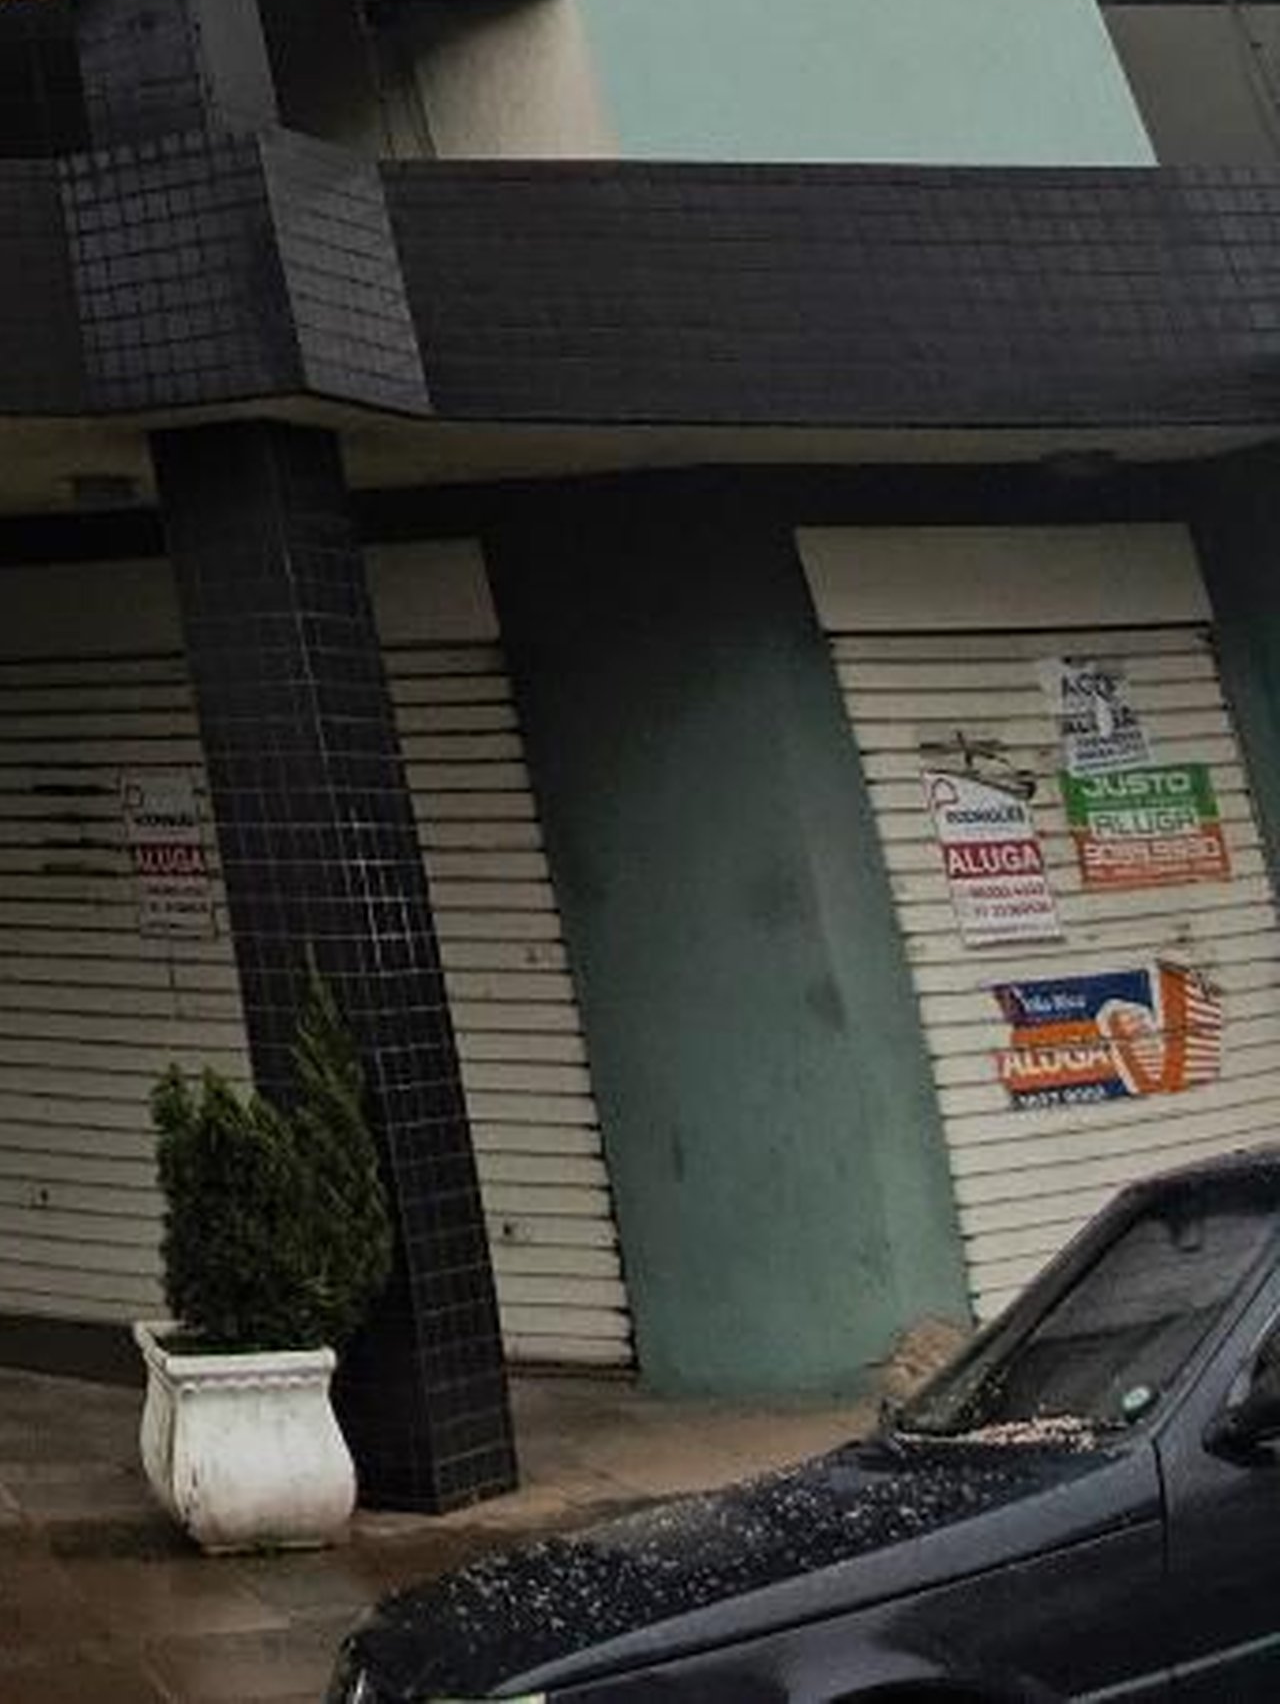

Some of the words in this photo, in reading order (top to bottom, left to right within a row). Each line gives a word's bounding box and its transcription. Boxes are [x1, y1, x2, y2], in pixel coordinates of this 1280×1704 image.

[1081, 772, 1191, 797] JUSTO
[948, 844, 1040, 875] ALUGA
[1002, 1046, 1111, 1079] ALUGA
